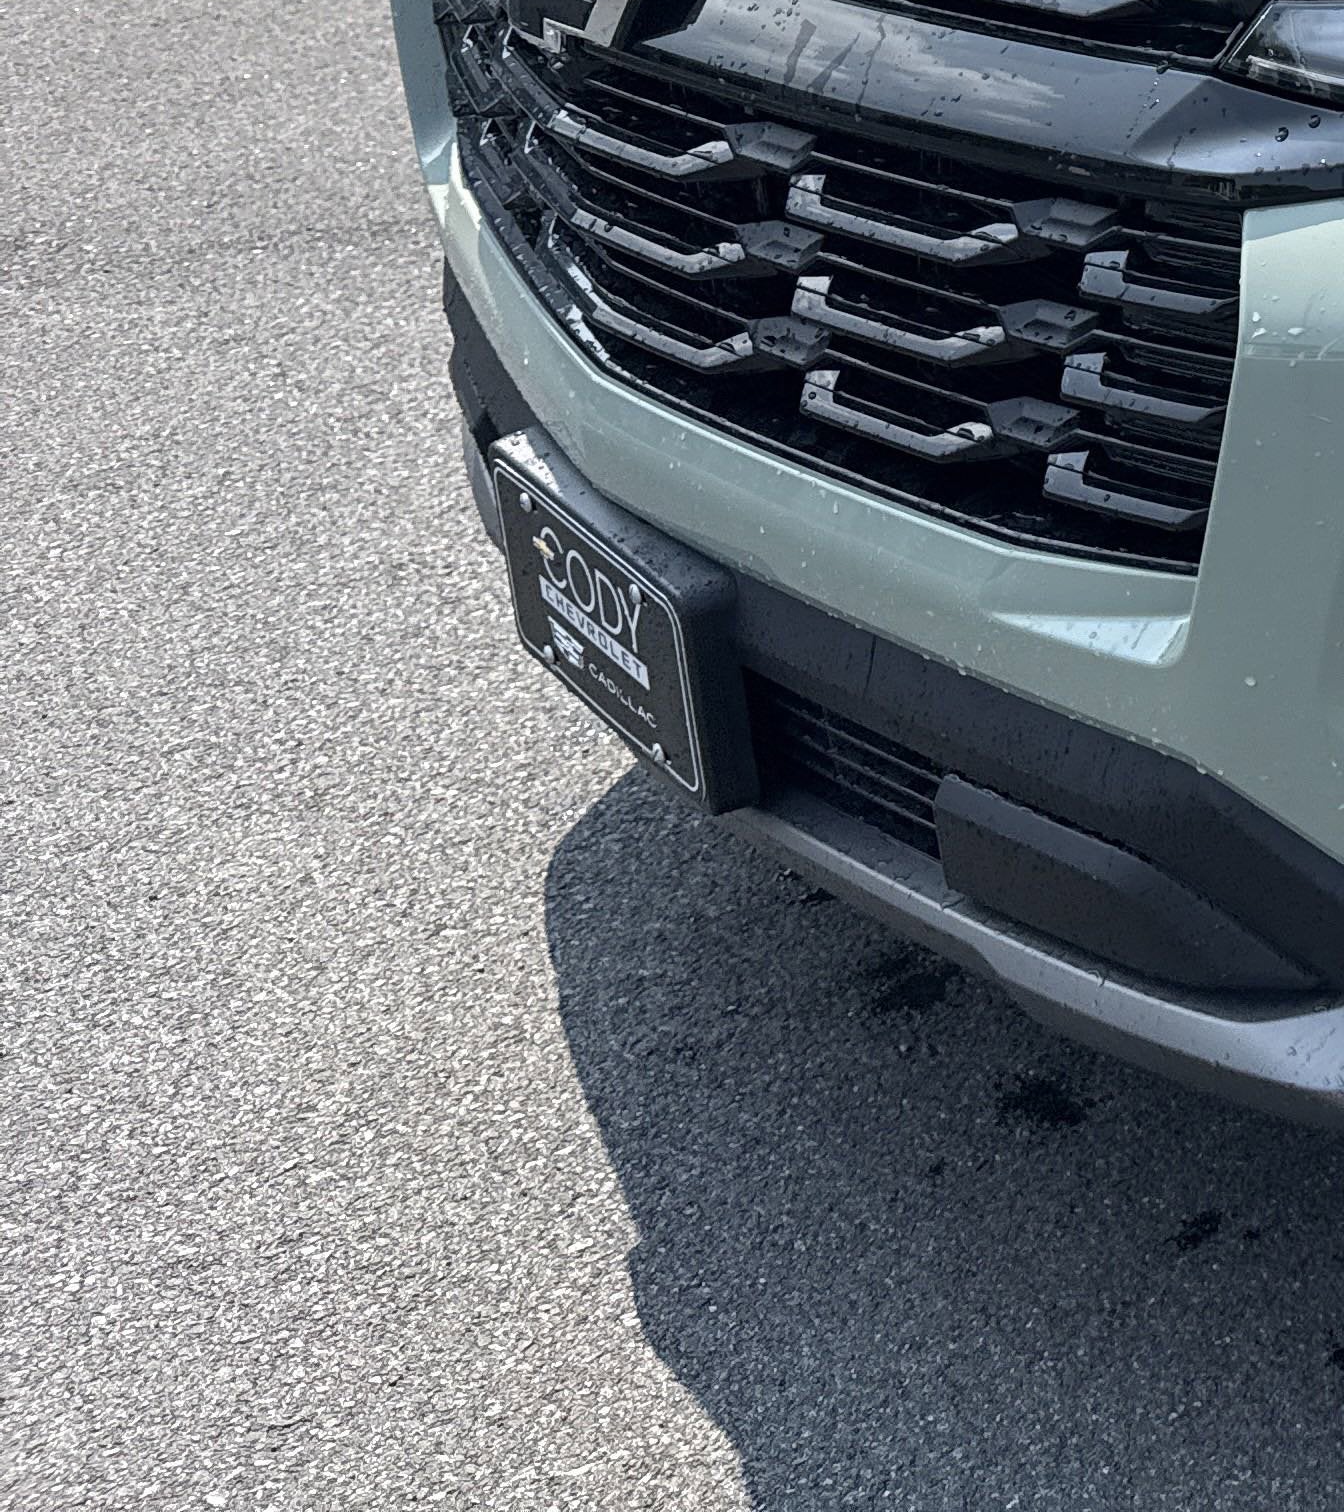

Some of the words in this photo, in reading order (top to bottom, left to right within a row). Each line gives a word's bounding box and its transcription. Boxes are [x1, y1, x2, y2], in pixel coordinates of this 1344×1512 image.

[540, 526, 639, 654] CODY
[545, 584, 643, 679] CHEVROLET
[588, 662, 658, 728] CADILLAC
